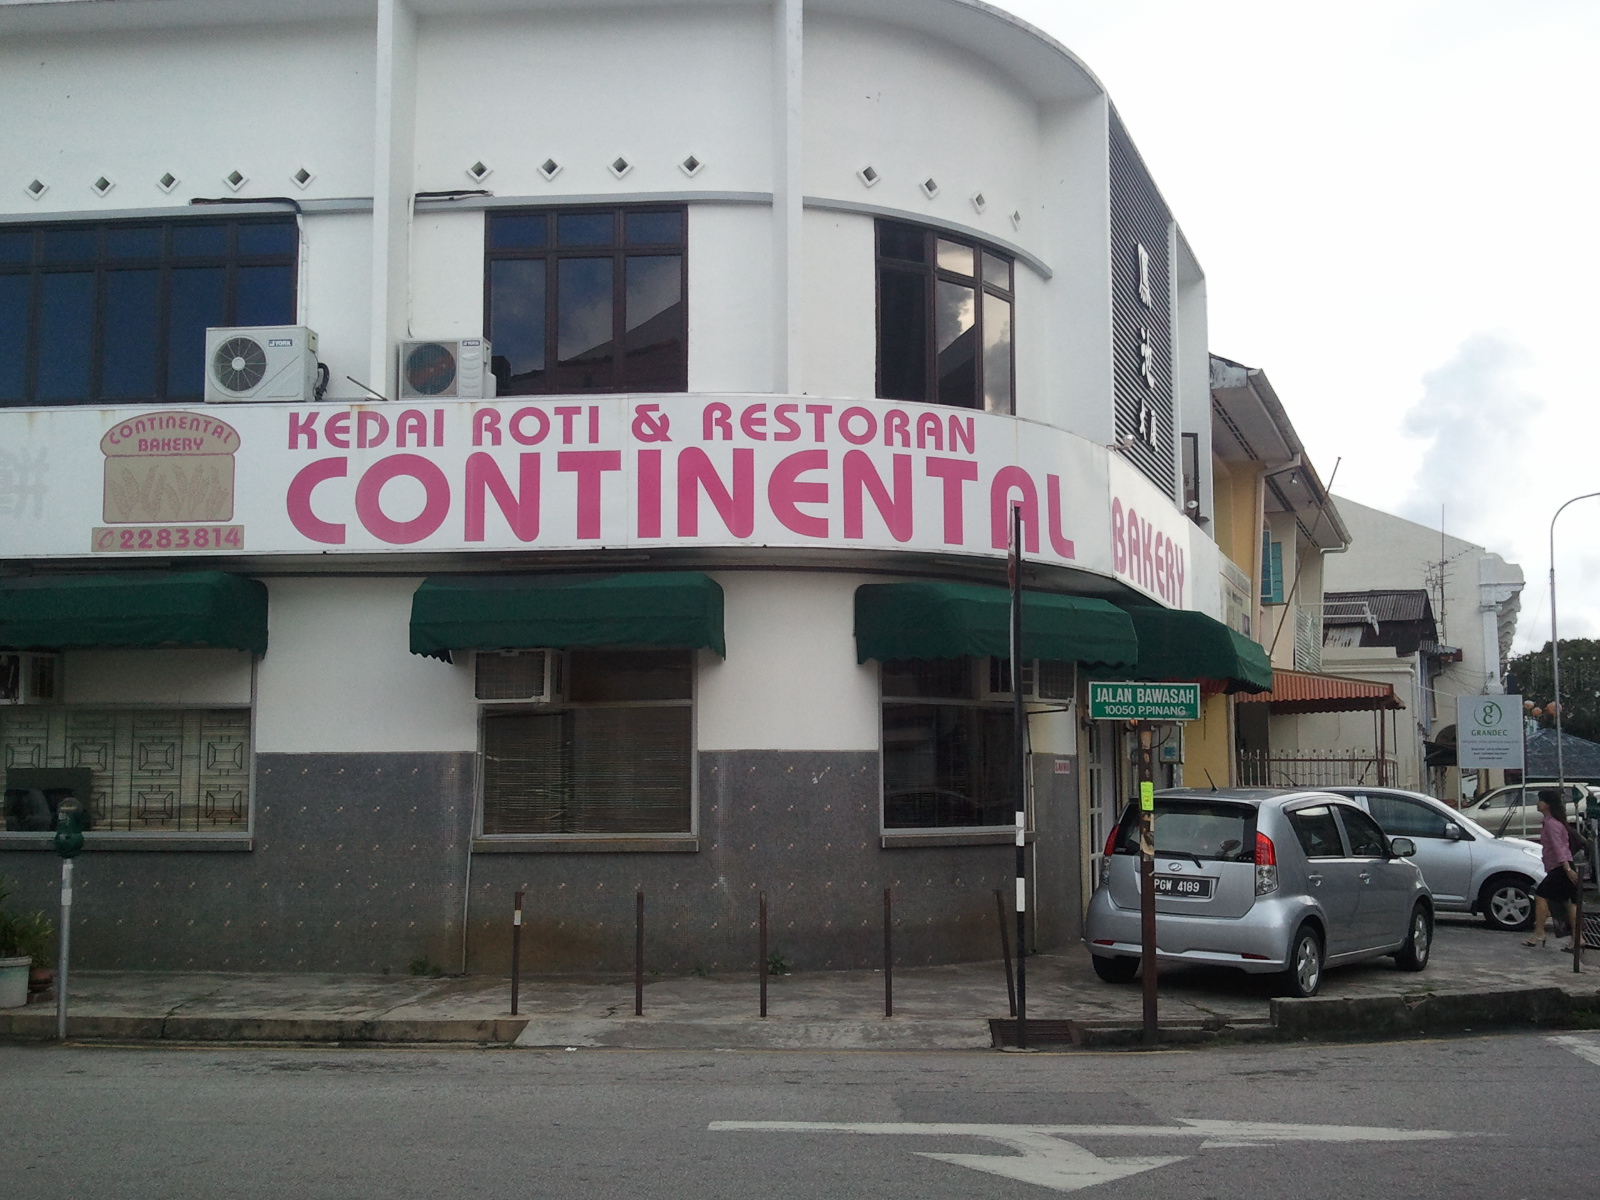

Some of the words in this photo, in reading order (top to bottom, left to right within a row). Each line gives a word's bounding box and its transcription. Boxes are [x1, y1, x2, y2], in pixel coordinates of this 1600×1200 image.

[108, 415, 232, 445] CONTINENTAL
[287, 406, 446, 450] KEDAI
[472, 404, 600, 446] ROTI
[631, 402, 673, 442] &
[702, 400, 976, 455] RESTORAN
[137, 437, 204, 452] BAKERY
[286, 445, 1075, 560] CONTINENTAL
[119, 527, 241, 549] 2283814
[1111, 496, 1185, 611] BAKERY
[1095, 687, 1133, 703] JALAN
[1136, 688, 1195, 704] BAWASAH
[1104, 705, 1136, 715] 10050
[1138, 706, 1187, 716] P.PINANG
[1471, 729, 1508, 737] GRANDEC
[1154, 879, 1173, 891] PGW
[1177, 881, 1200, 893] 4189
